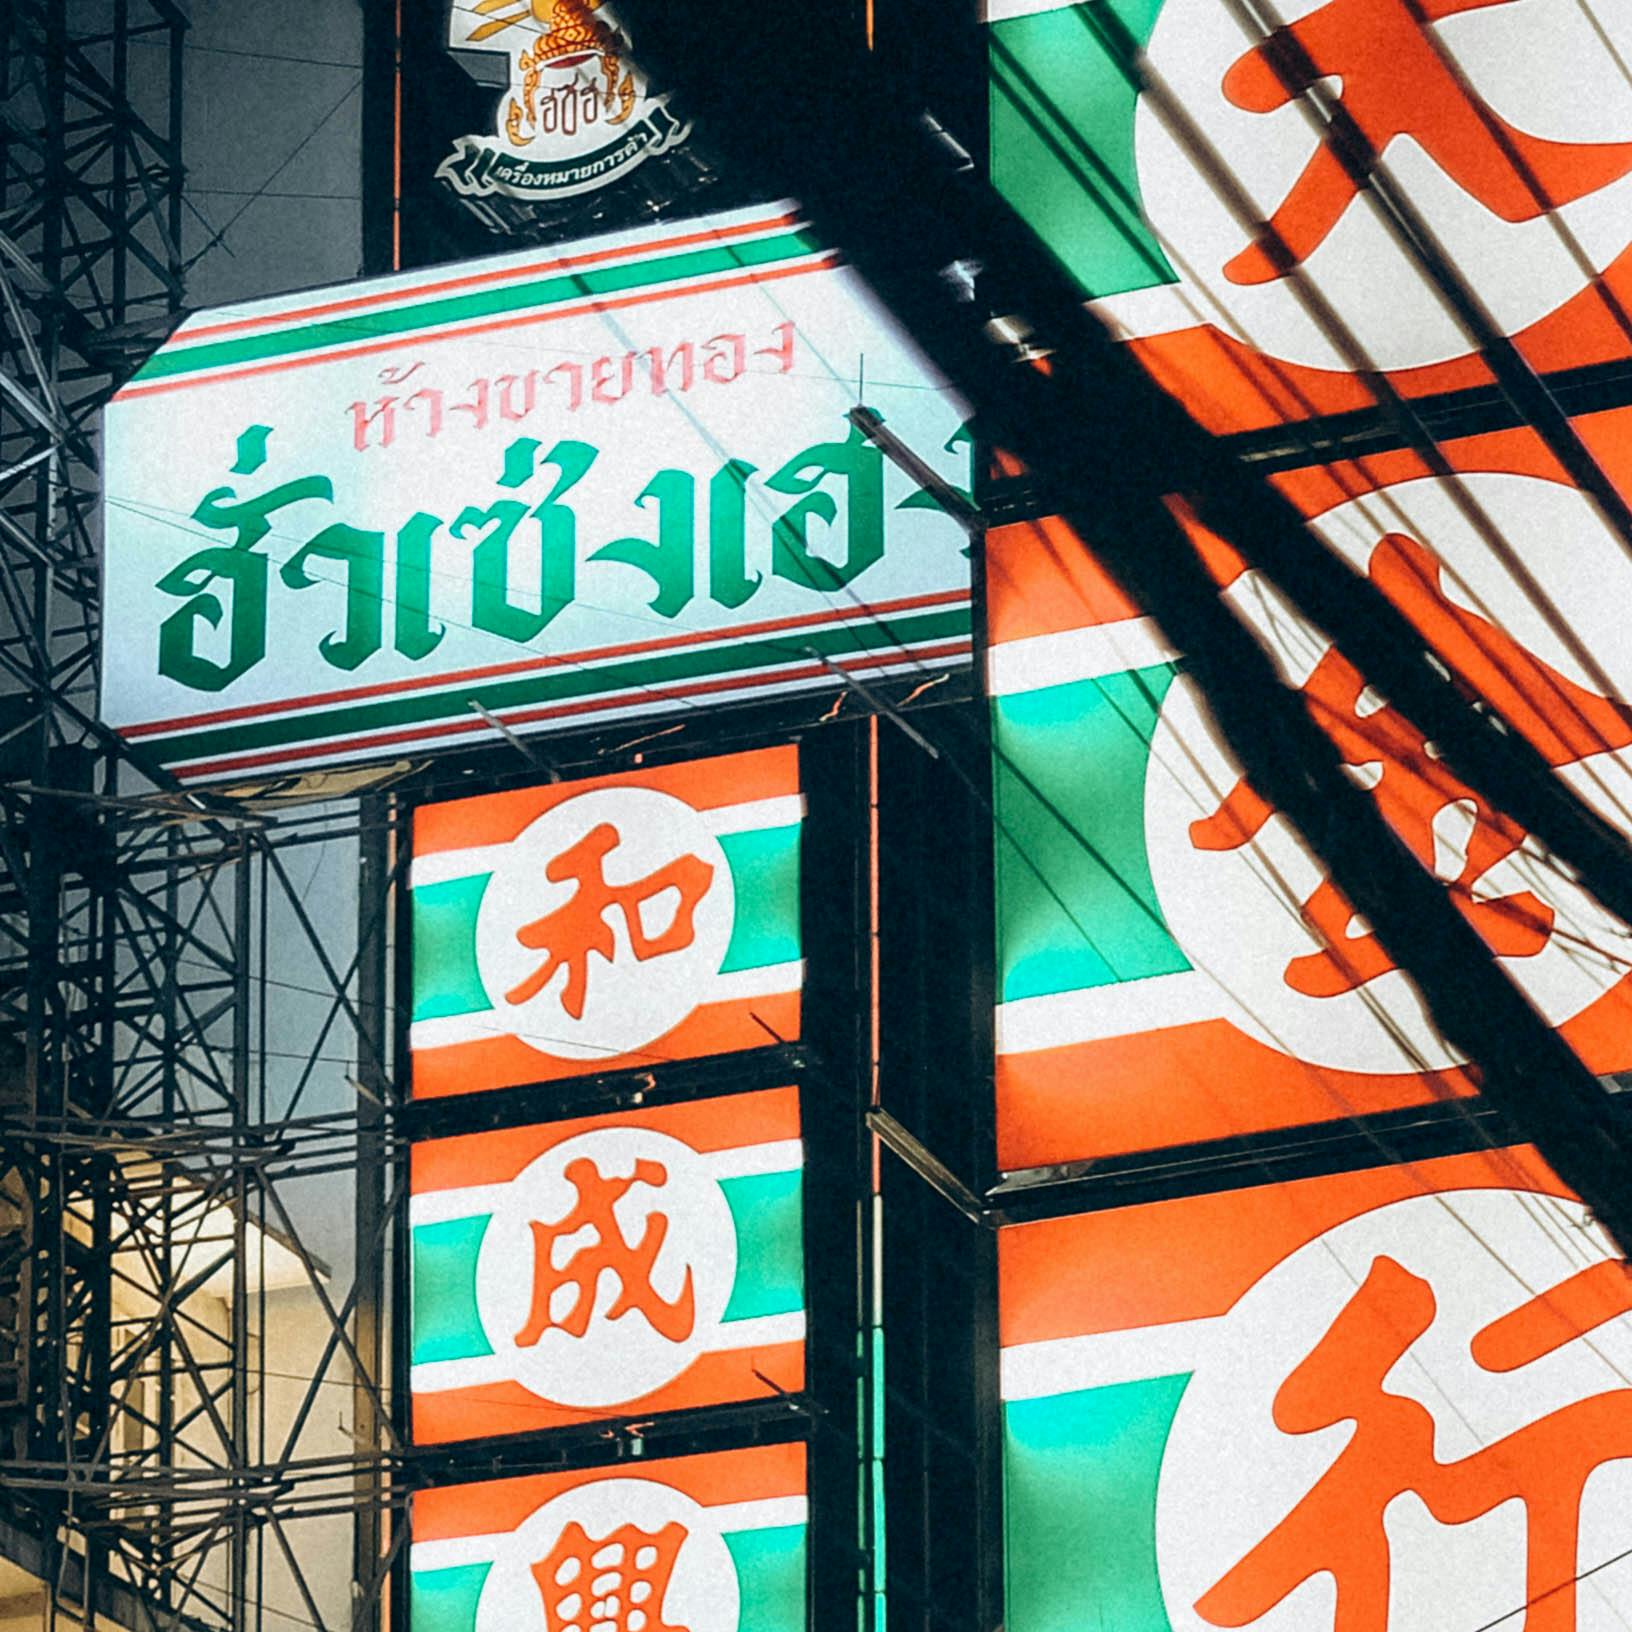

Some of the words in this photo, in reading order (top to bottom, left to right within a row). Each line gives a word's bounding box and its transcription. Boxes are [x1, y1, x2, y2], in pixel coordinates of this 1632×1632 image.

[496, 132, 649, 187] เครื่องหมายการค้า
[345, 320, 798, 453] ห้างขายทอง
